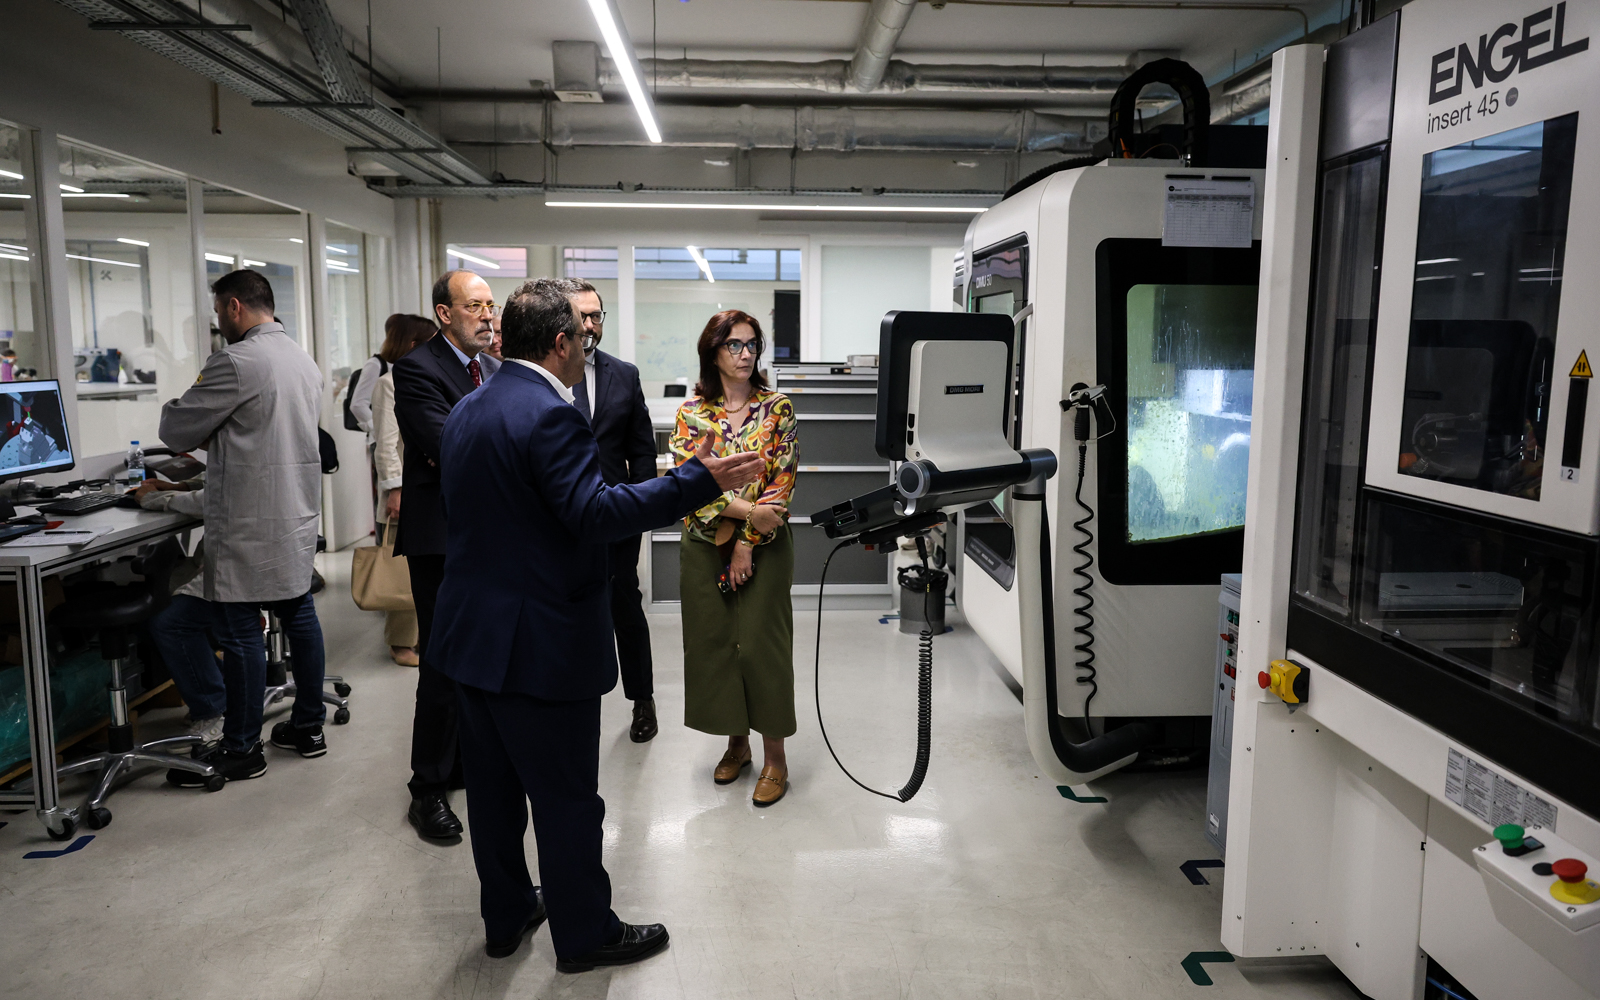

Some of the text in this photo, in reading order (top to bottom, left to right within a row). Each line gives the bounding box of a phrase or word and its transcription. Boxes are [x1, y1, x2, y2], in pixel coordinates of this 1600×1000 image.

[1429, 1, 1589, 105] ENGEL
[1427, 101, 1472, 134] insert
[1477, 91, 1500, 117] 45
[1567, 469, 1574, 480] 2
